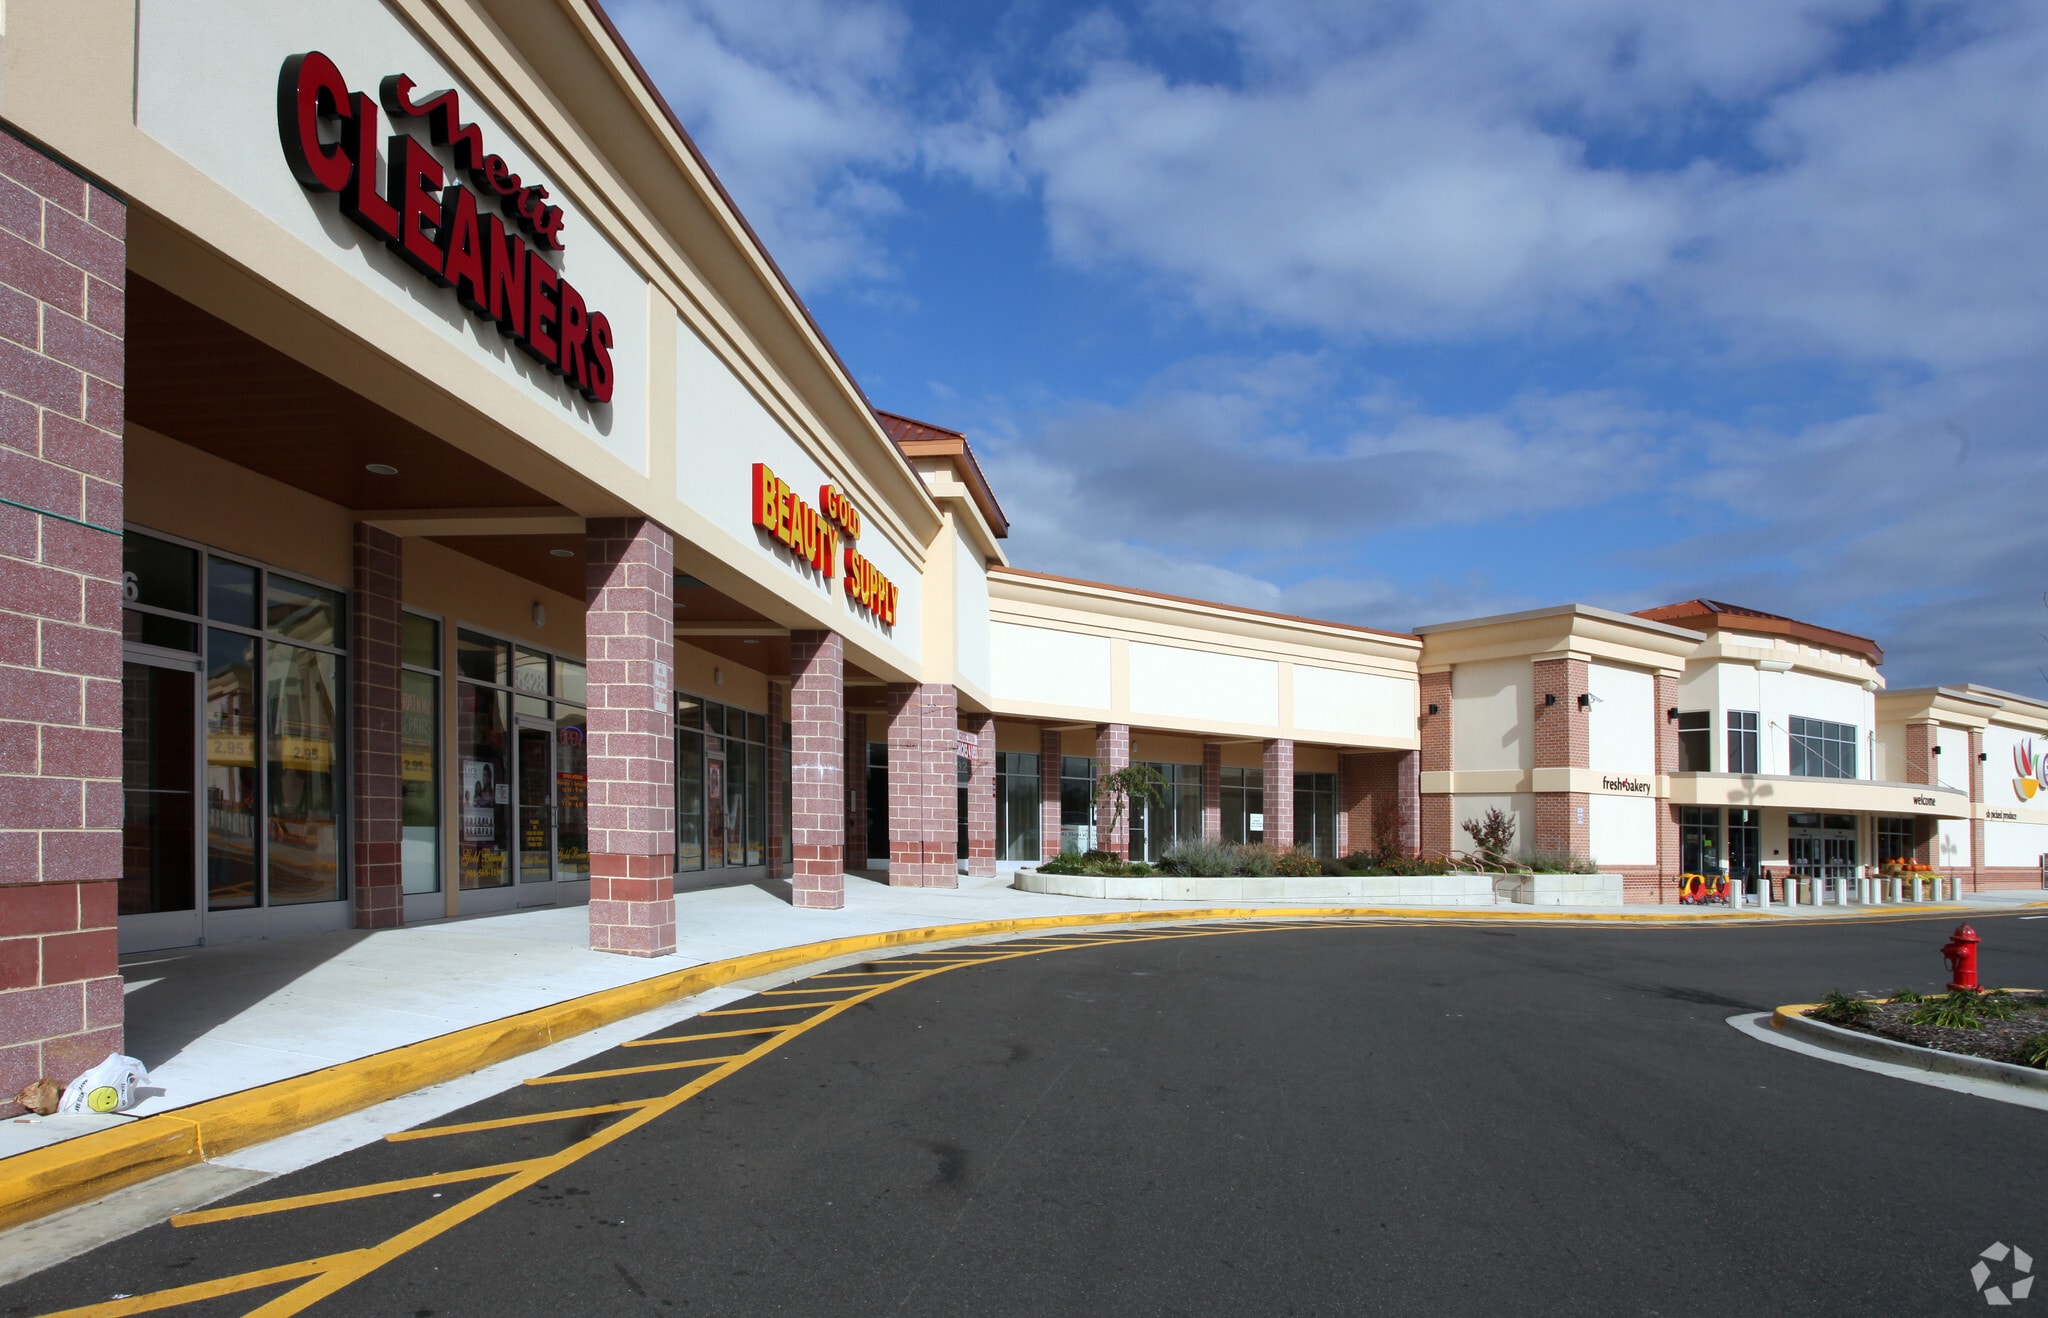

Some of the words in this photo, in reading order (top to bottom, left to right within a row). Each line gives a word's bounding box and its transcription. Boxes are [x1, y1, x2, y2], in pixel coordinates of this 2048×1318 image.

[379, 72, 565, 252] Merit
[278, 50, 614, 404] CLEANERS
[819, 484, 861, 541] GOLD
[752, 463, 839, 579] BEAUTY
[844, 547, 899, 627] SUPPLY
[214, 740, 245, 756] 2.95
[293, 746, 319, 761] 2.95
[1603, 776, 1622, 790] fresh
[1625, 778, 1650, 796] bakery
[1913, 794, 1936, 807] welcome
[461, 848, 480, 867] Gold
